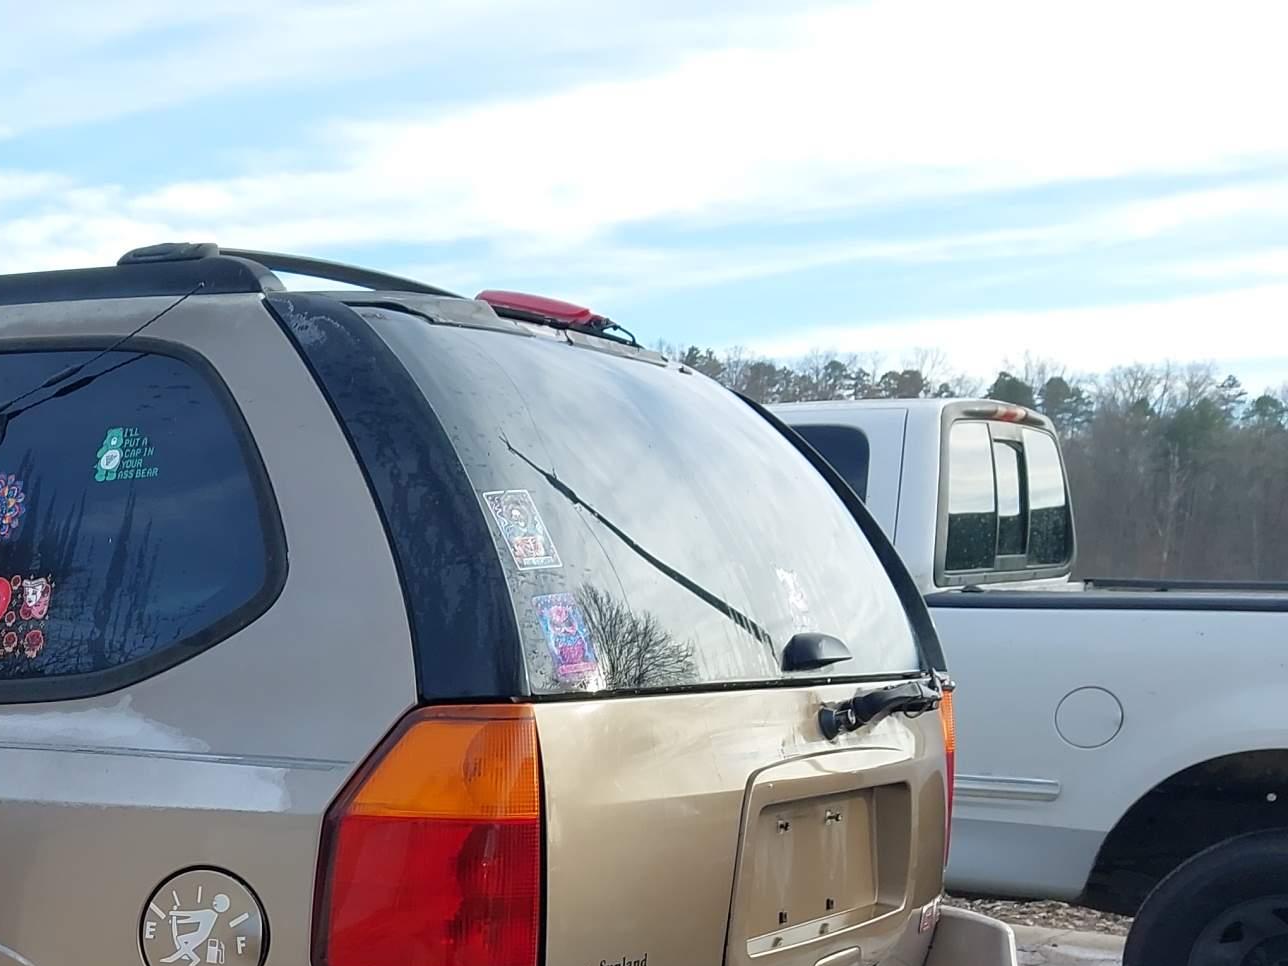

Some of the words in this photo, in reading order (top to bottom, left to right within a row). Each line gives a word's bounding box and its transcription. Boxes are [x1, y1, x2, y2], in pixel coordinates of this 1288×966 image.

[124, 438, 140, 448] PUT
[124, 448, 141, 458] CAP
[143, 447, 155, 457] IN
[121, 459, 143, 469] YOUR
[117, 470, 134, 480] ASS
[135, 467, 159, 479] BEAR
[145, 921, 157, 939] E
[236, 936, 246, 954] F
